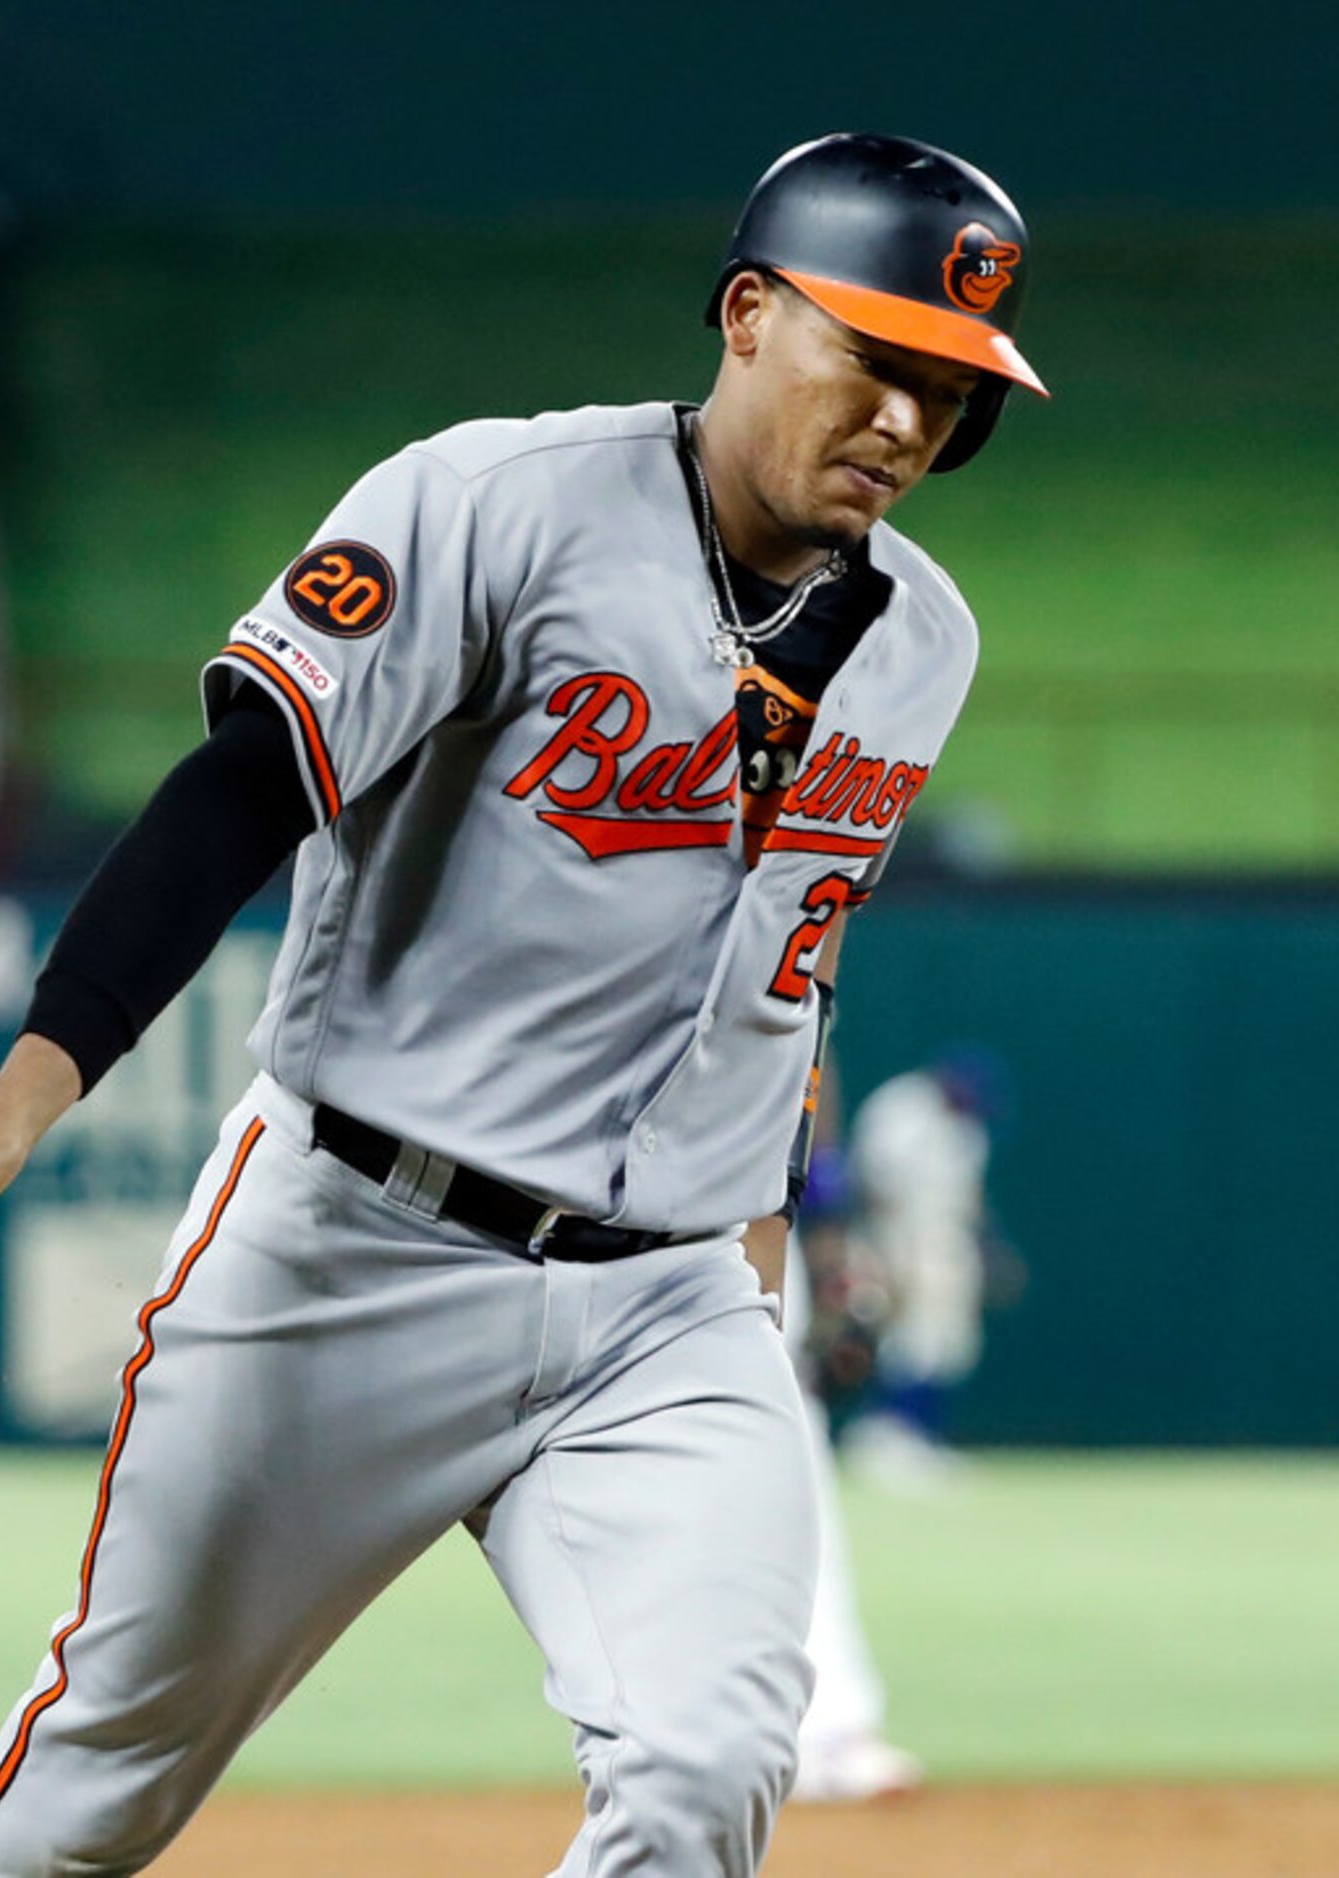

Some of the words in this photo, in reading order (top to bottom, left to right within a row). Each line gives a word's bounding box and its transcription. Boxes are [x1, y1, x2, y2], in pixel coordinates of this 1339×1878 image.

[292, 553, 382, 626] 20
[239, 620, 279, 644] MLB
[766, 871, 873, 1003] 2
